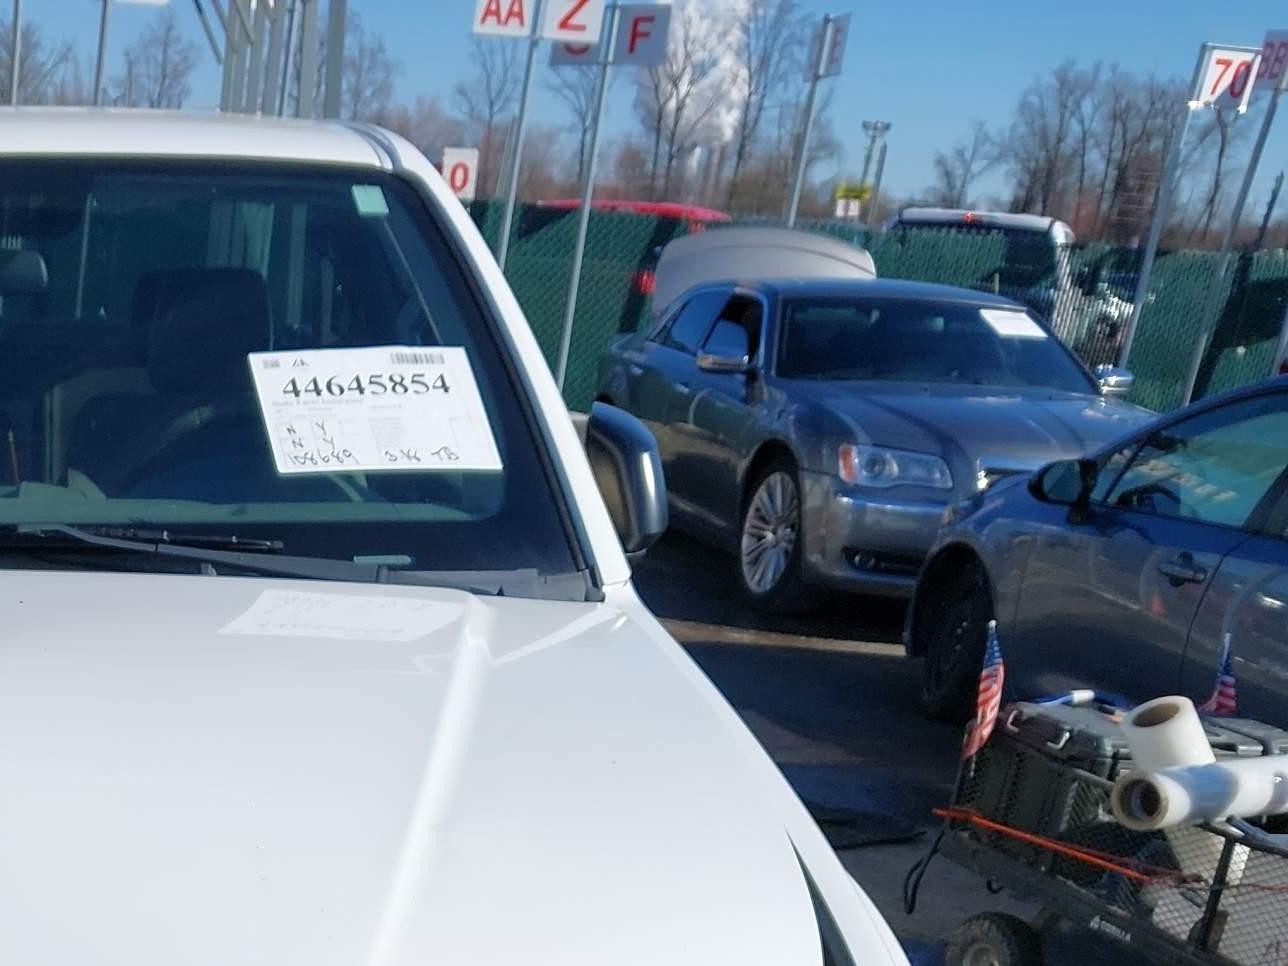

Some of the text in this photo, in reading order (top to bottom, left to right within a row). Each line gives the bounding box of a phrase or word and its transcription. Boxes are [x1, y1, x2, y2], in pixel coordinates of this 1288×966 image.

[480, 0, 524, 27] AA
[557, 0, 586, 31] Z
[628, 16, 655, 53] F
[1210, 57, 1252, 98] 70
[282, 372, 451, 399] 44645854
